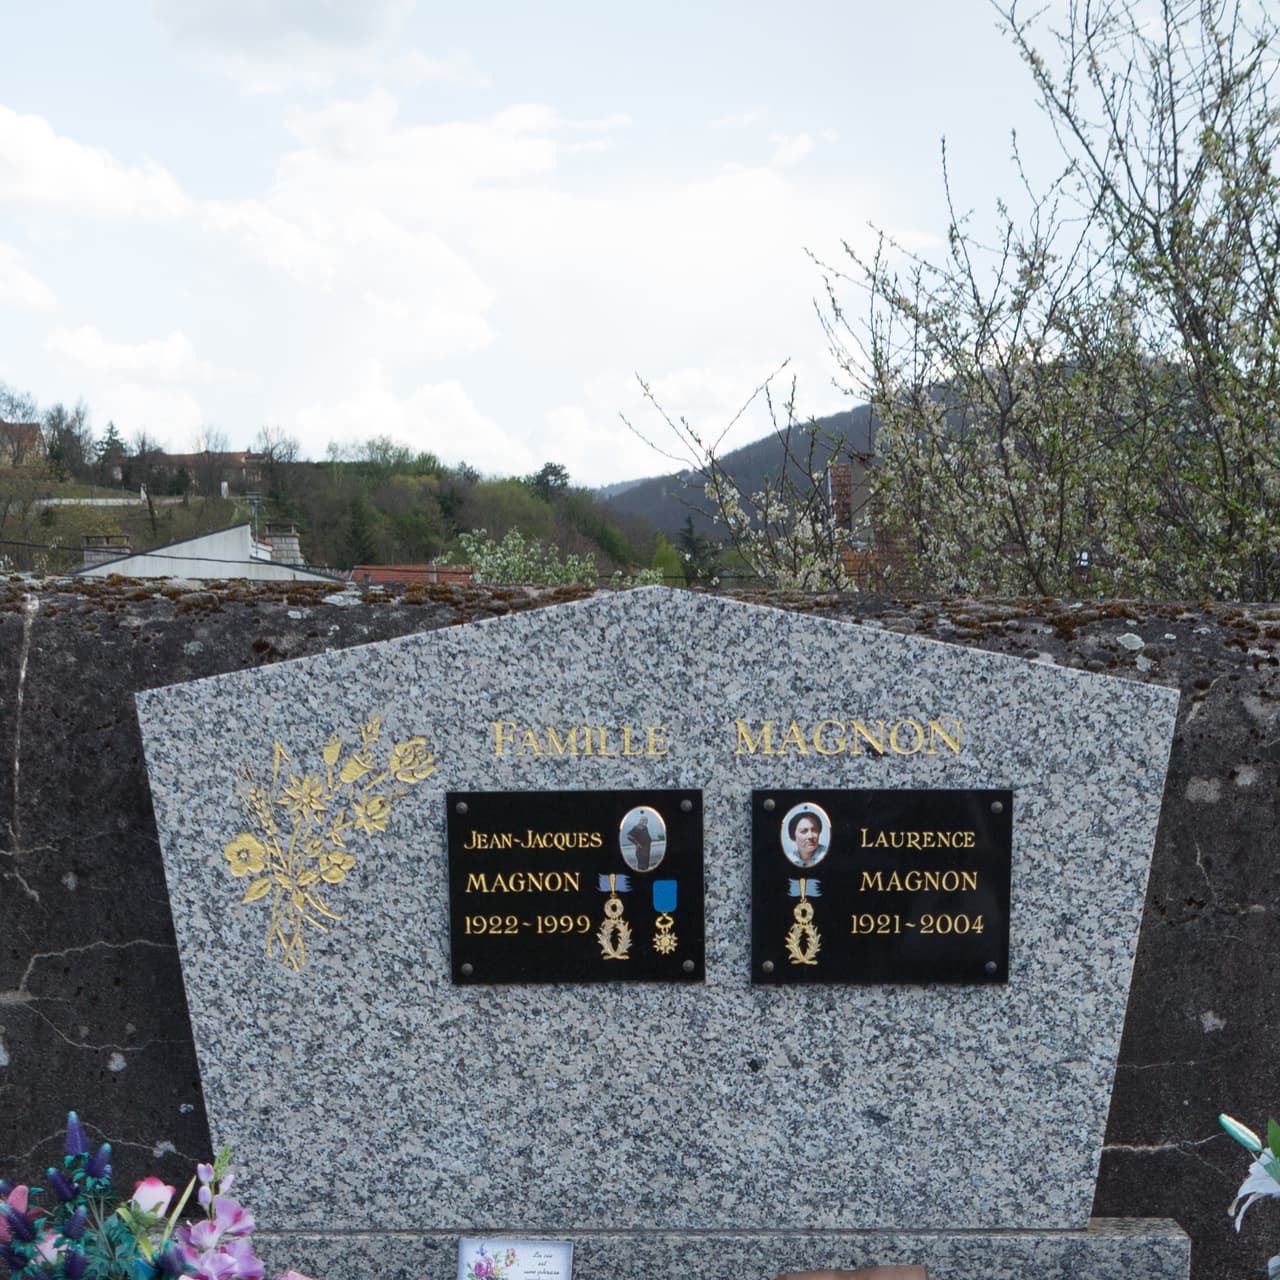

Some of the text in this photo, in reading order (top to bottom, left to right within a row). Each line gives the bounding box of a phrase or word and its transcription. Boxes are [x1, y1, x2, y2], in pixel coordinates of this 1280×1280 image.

[491, 719, 964, 757] FAMILLE MAGNON
[464, 829, 603, 851] JEAN-JACQUES
[860, 827, 976, 851] LAURENCE
[465, 872, 580, 893] MAGNON
[859, 870, 978, 892] MAGNON
